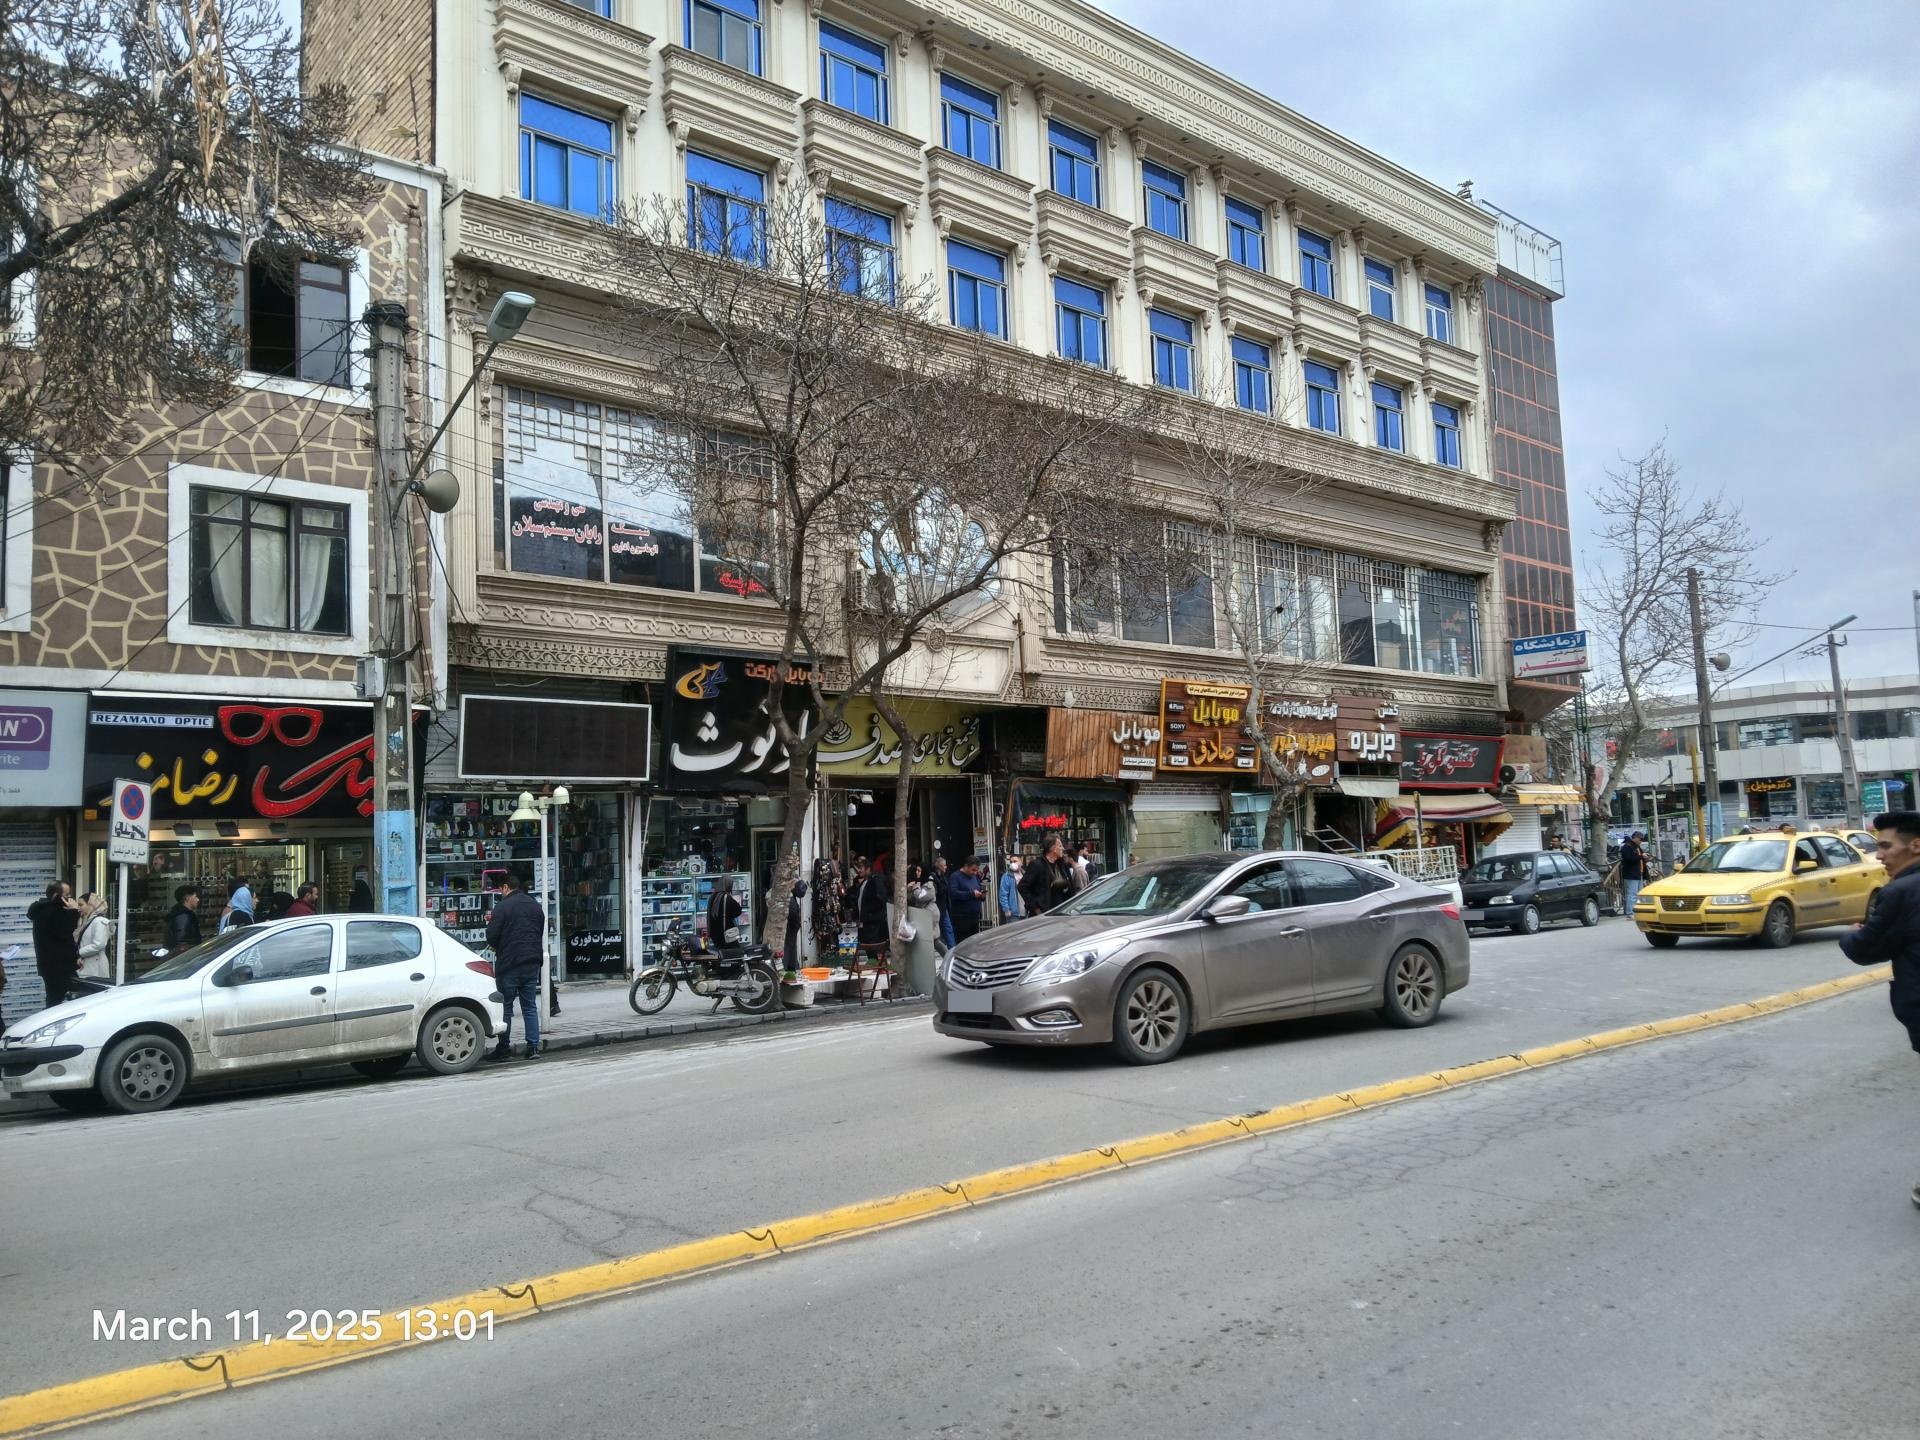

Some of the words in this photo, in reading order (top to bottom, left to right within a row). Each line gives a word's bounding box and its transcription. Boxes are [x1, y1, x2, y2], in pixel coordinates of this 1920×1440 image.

[512, 515, 544, 538] سبلان
[544, 521, 576, 542] سیستم
[575, 523, 603, 545] رایان
[1514, 632, 1584, 652] آزمایشگاه
[1193, 698, 1239, 726] موبایل
[1377, 700, 1399, 718] کفش
[95, 713, 166, 725] REZAMAND
[174, 716, 210, 727] OPTIC
[912, 725, 953, 765] تجاری
[1112, 720, 1161, 752] موبایل
[1350, 722, 1396, 762] جزیره
[1192, 728, 1234, 766] صادق
[1750, 780, 1777, 792] موبایل
[1776, 778, 1792, 789] دکتر
[571, 932, 592, 946] فوری
[592, 932, 622, 946] تعمیرات
